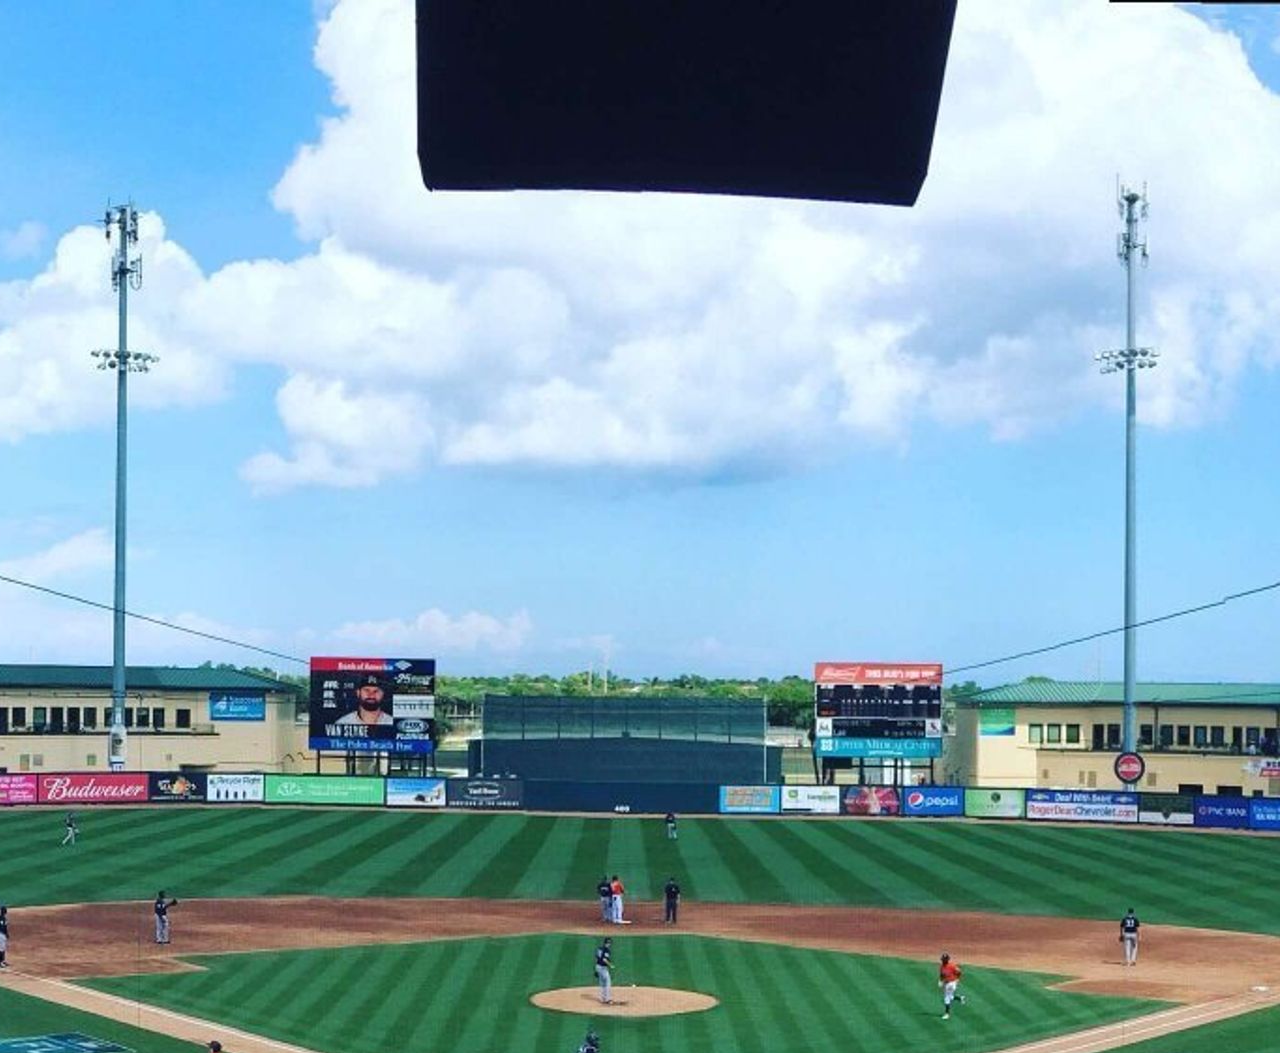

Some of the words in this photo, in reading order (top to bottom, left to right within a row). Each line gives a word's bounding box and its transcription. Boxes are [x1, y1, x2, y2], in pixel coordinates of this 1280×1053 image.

[44, 777, 145, 800] Budweiser
[925, 795, 958, 809] pepsi
[1029, 803, 1136, 818] RogerDeanChevrolet.com
